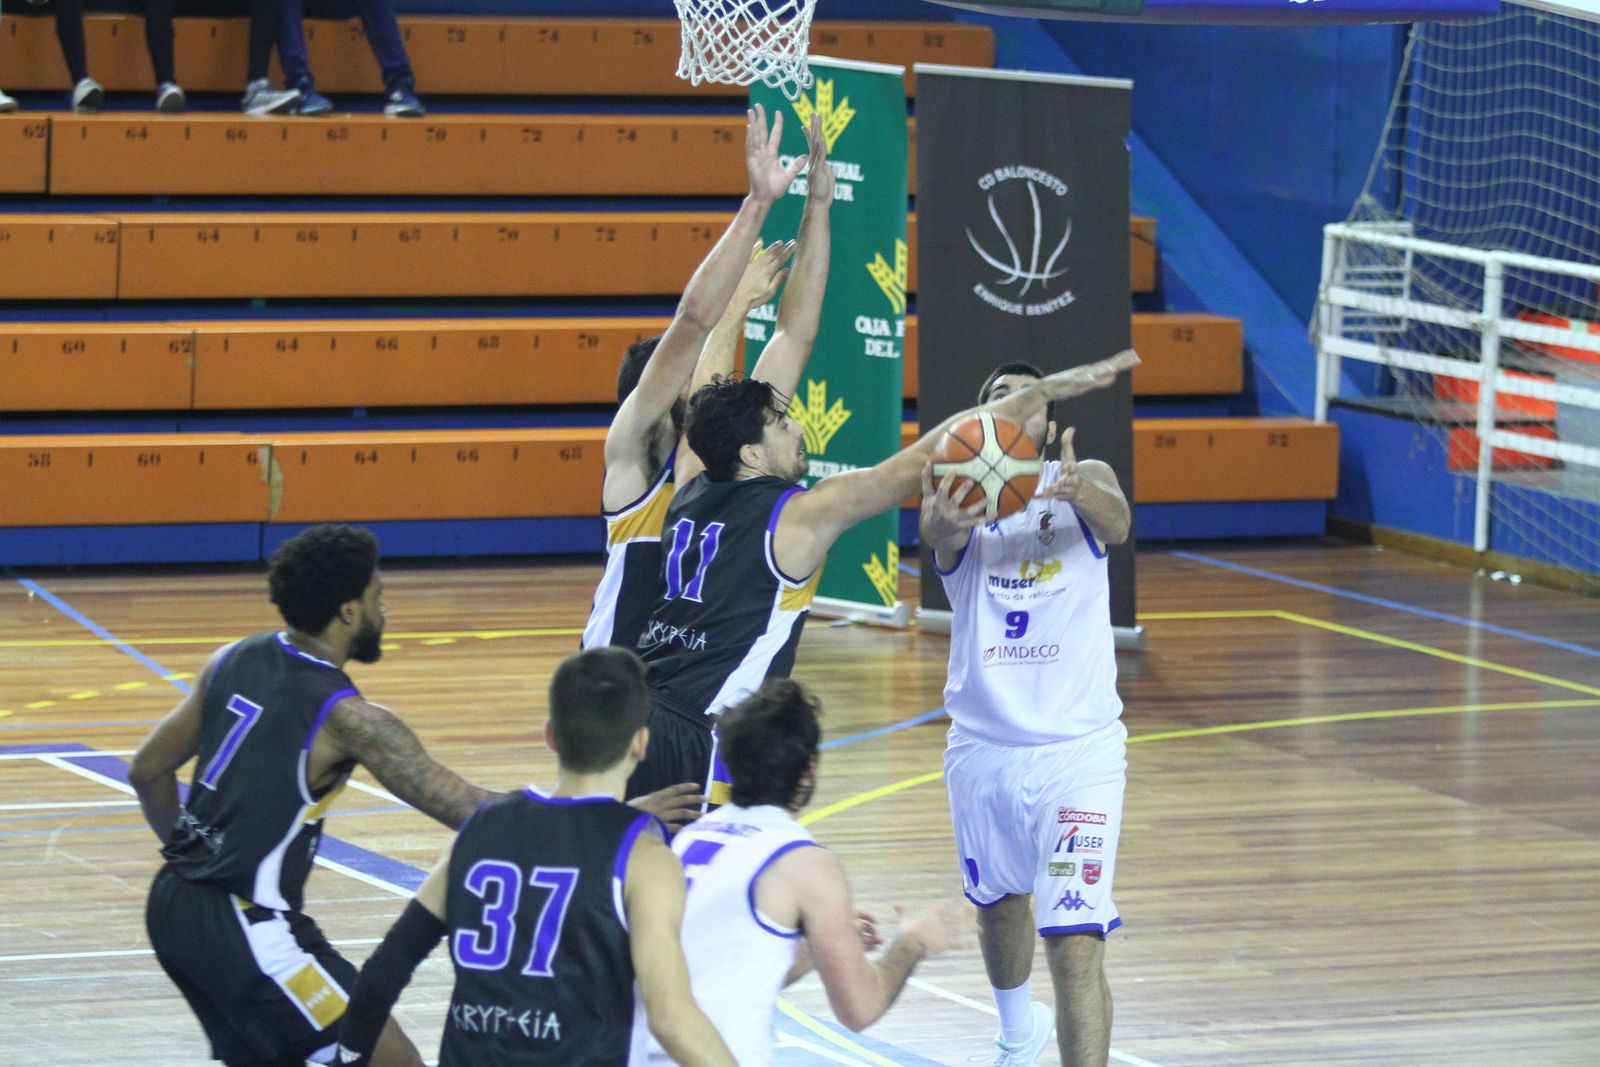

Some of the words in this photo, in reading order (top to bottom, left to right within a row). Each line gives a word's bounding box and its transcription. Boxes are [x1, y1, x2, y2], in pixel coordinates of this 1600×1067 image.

[864, 338, 900, 358] DEL
[664, 517, 725, 603] 11
[988, 574, 1036, 589] muser
[1004, 610, 1030, 639] 9
[998, 643, 1060, 659] IMDECO
[200, 694, 263, 791] 7
[454, 859, 580, 977] 37
